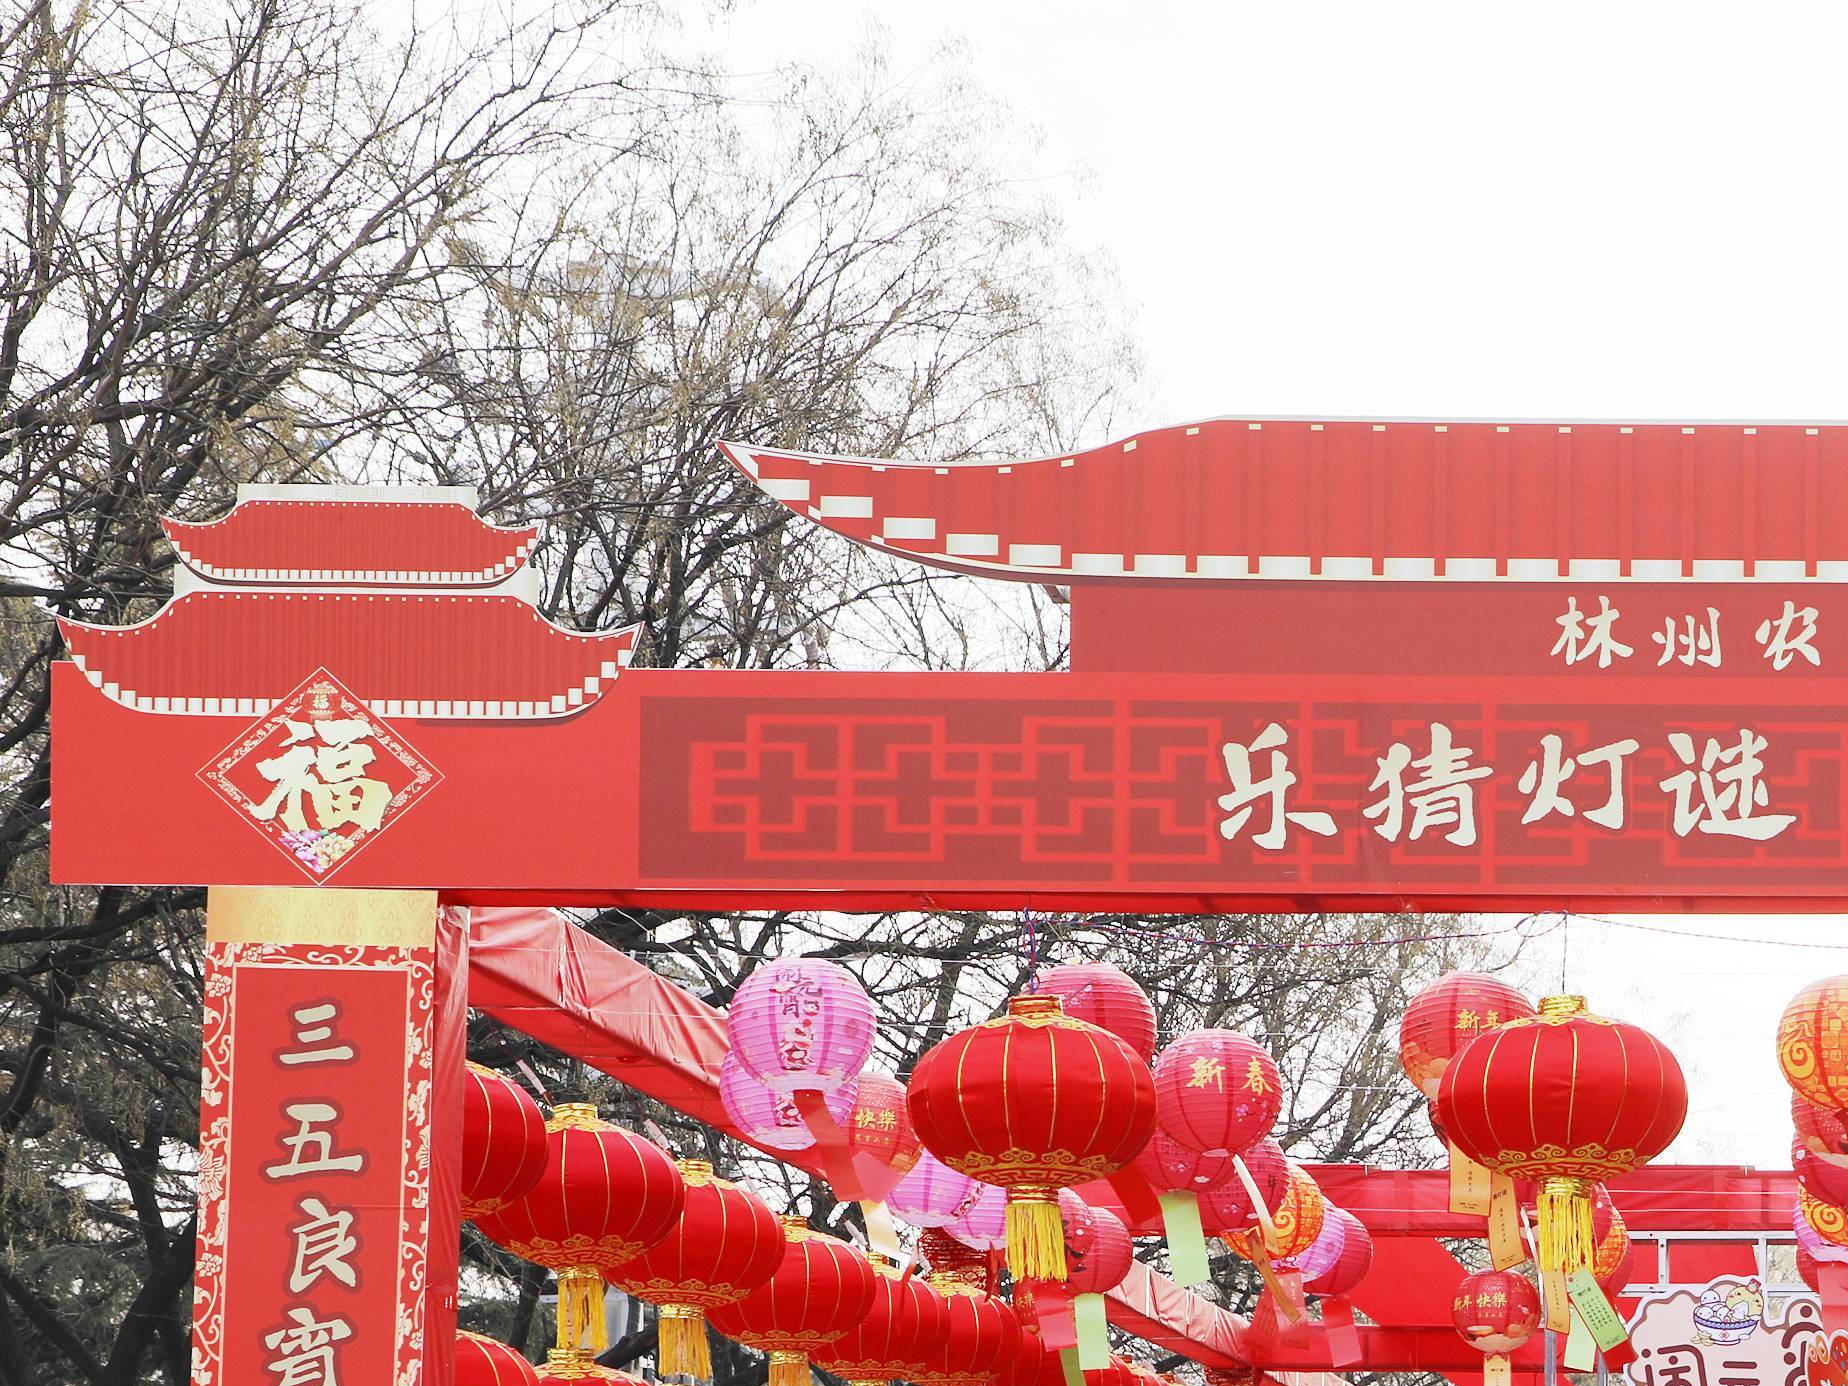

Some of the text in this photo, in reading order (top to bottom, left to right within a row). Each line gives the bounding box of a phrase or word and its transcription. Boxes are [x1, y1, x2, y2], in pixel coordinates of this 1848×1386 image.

[247, 718, 393, 834] 福
[1217, 722, 1797, 851] 乐猜灯谜
[1186, 1055, 1275, 1097] 新春
